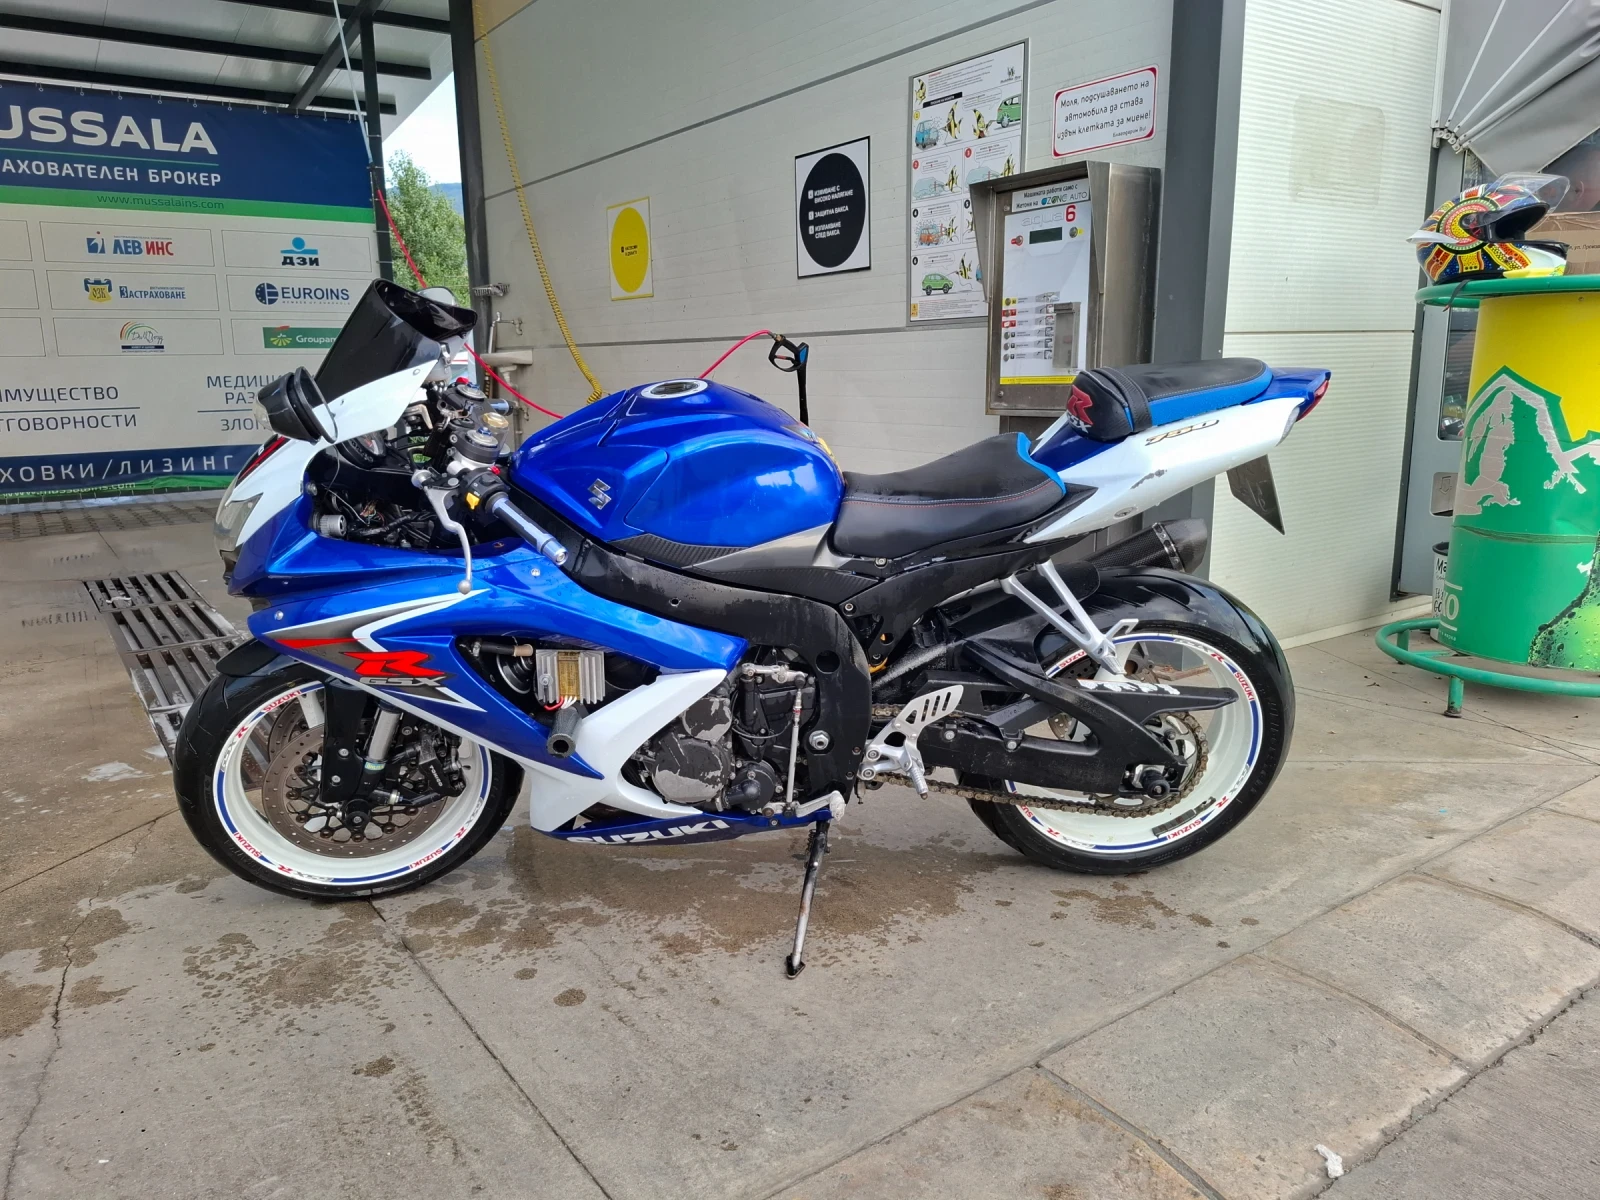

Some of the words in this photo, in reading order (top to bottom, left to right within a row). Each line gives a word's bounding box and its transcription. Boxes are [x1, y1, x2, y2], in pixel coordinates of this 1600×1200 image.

[1060, 98, 1080, 108] Моля,
[1081, 83, 1138, 104] подсушаването
[1140, 80, 1150, 88] на
[1064, 106, 1108, 123] автомобила
[1109, 103, 1118, 114] да
[1119, 96, 1144, 109] става
[1057, 128, 1077, 141] извън
[1078, 119, 1115, 134] клетката
[1116, 118, 1125, 128] за
[1126, 110, 1152, 123] миене!
[1, 158, 139, 182] АХОВАТЕЛЕН
[148, 169, 221, 187] БРОКЕР
[97, 195, 225, 209] www.mussalains.com
[1069, 191, 1088, 200] AUTO
[814, 207, 835, 218] ЗАЩИТНА
[1065, 204, 1077, 222] 6
[113, 239, 143, 255] ЛЕВ
[145, 240, 174, 256] ИНС
[281, 255, 320, 267] ДЗИ
[119, 285, 186, 300] ЗАСТРАХОВАНЕ
[281, 286, 350, 301] EUROINS
[0, 386, 119, 404] МУЩЕСТВО
[1058, 649, 1088, 668] SUZU
[359, 676, 447, 687] GSX
[1234, 671, 1255, 701] SUZUKI
[263, 690, 302, 713] SUZUKI
[566, 819, 731, 845] SUZUKI
[1167, 818, 1202, 840] SUZUKI
[233, 831, 262, 858] SUZUKI
[408, 848, 443, 869] SUZUKI
